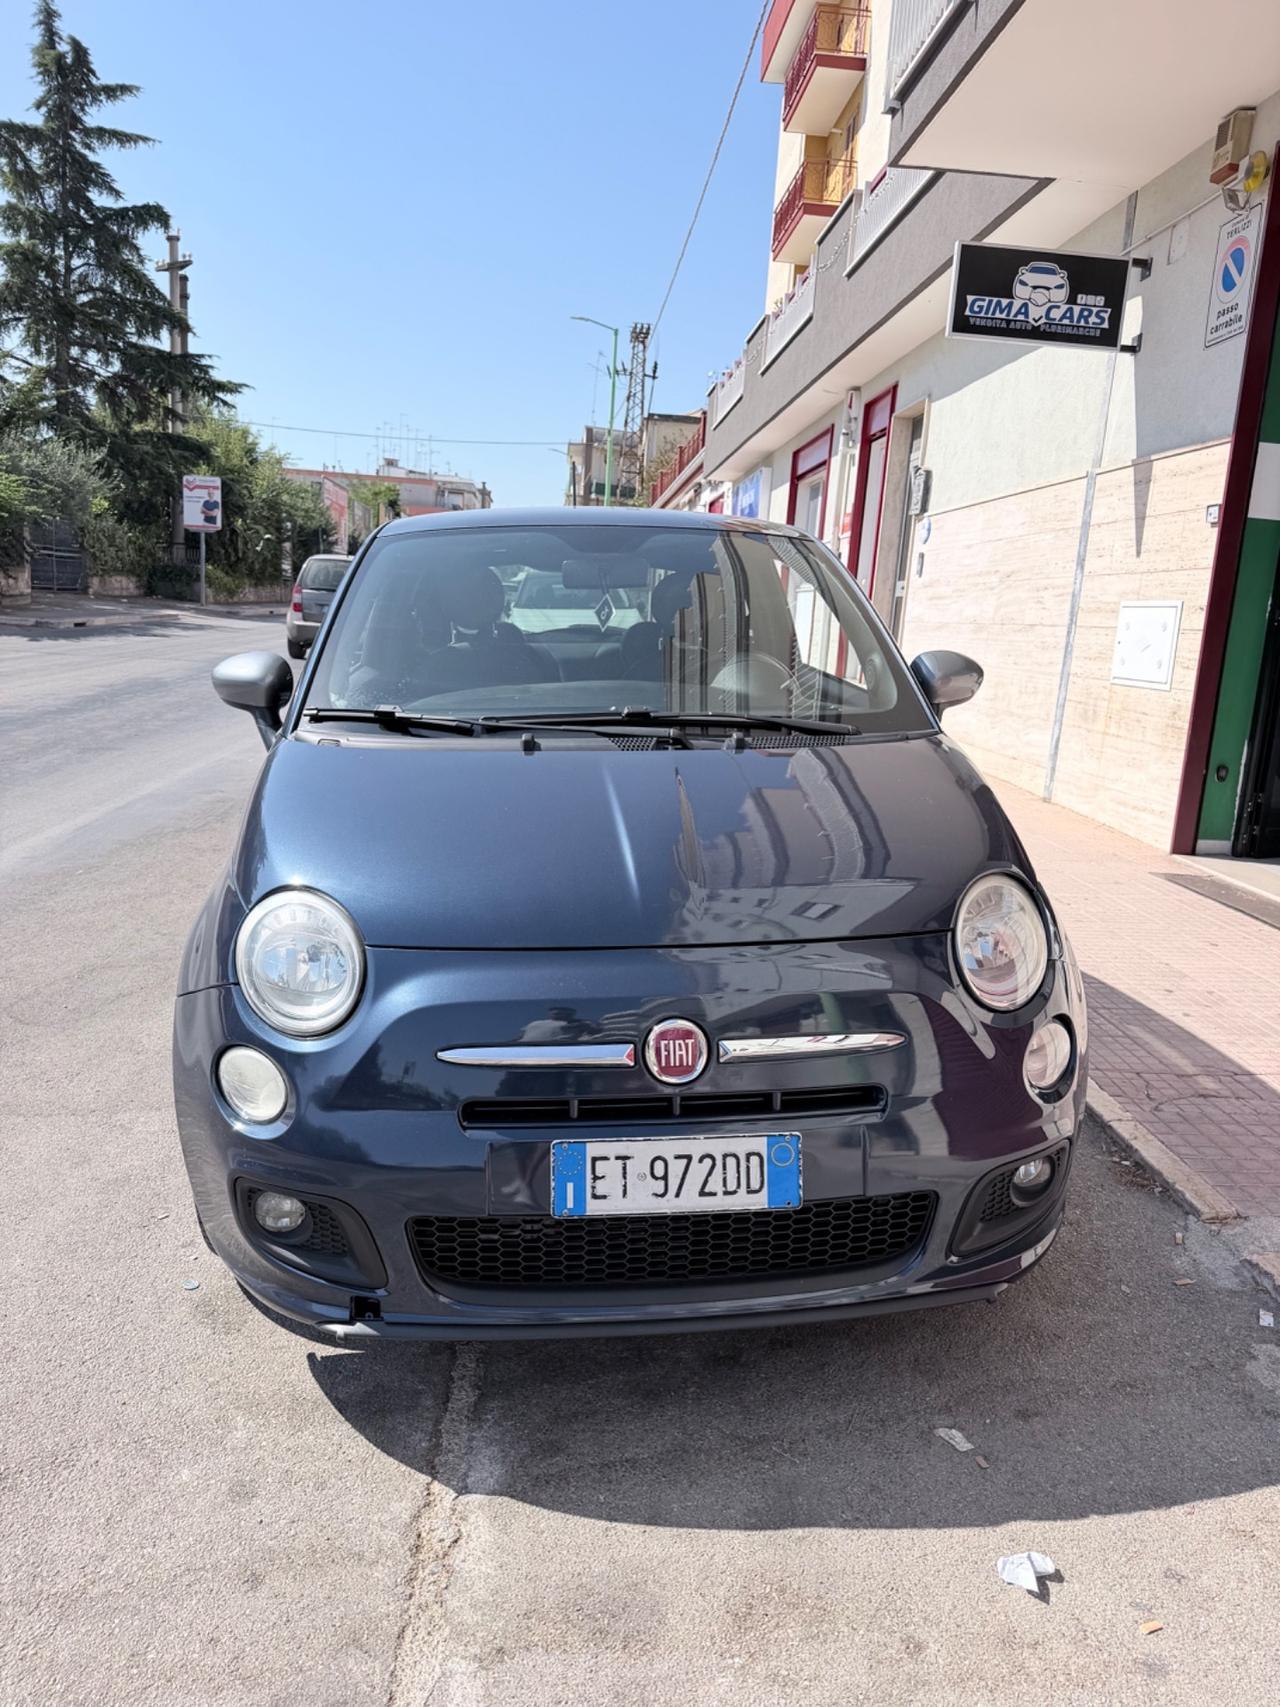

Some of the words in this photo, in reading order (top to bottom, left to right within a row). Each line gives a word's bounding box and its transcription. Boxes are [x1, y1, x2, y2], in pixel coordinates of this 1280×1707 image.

[968, 297, 1030, 319] GIMA
[1044, 304, 1109, 326] CARS
[1210, 313, 1243, 335] carrabile
[1216, 302, 1239, 321] passo
[660, 1038, 695, 1067] FIAT
